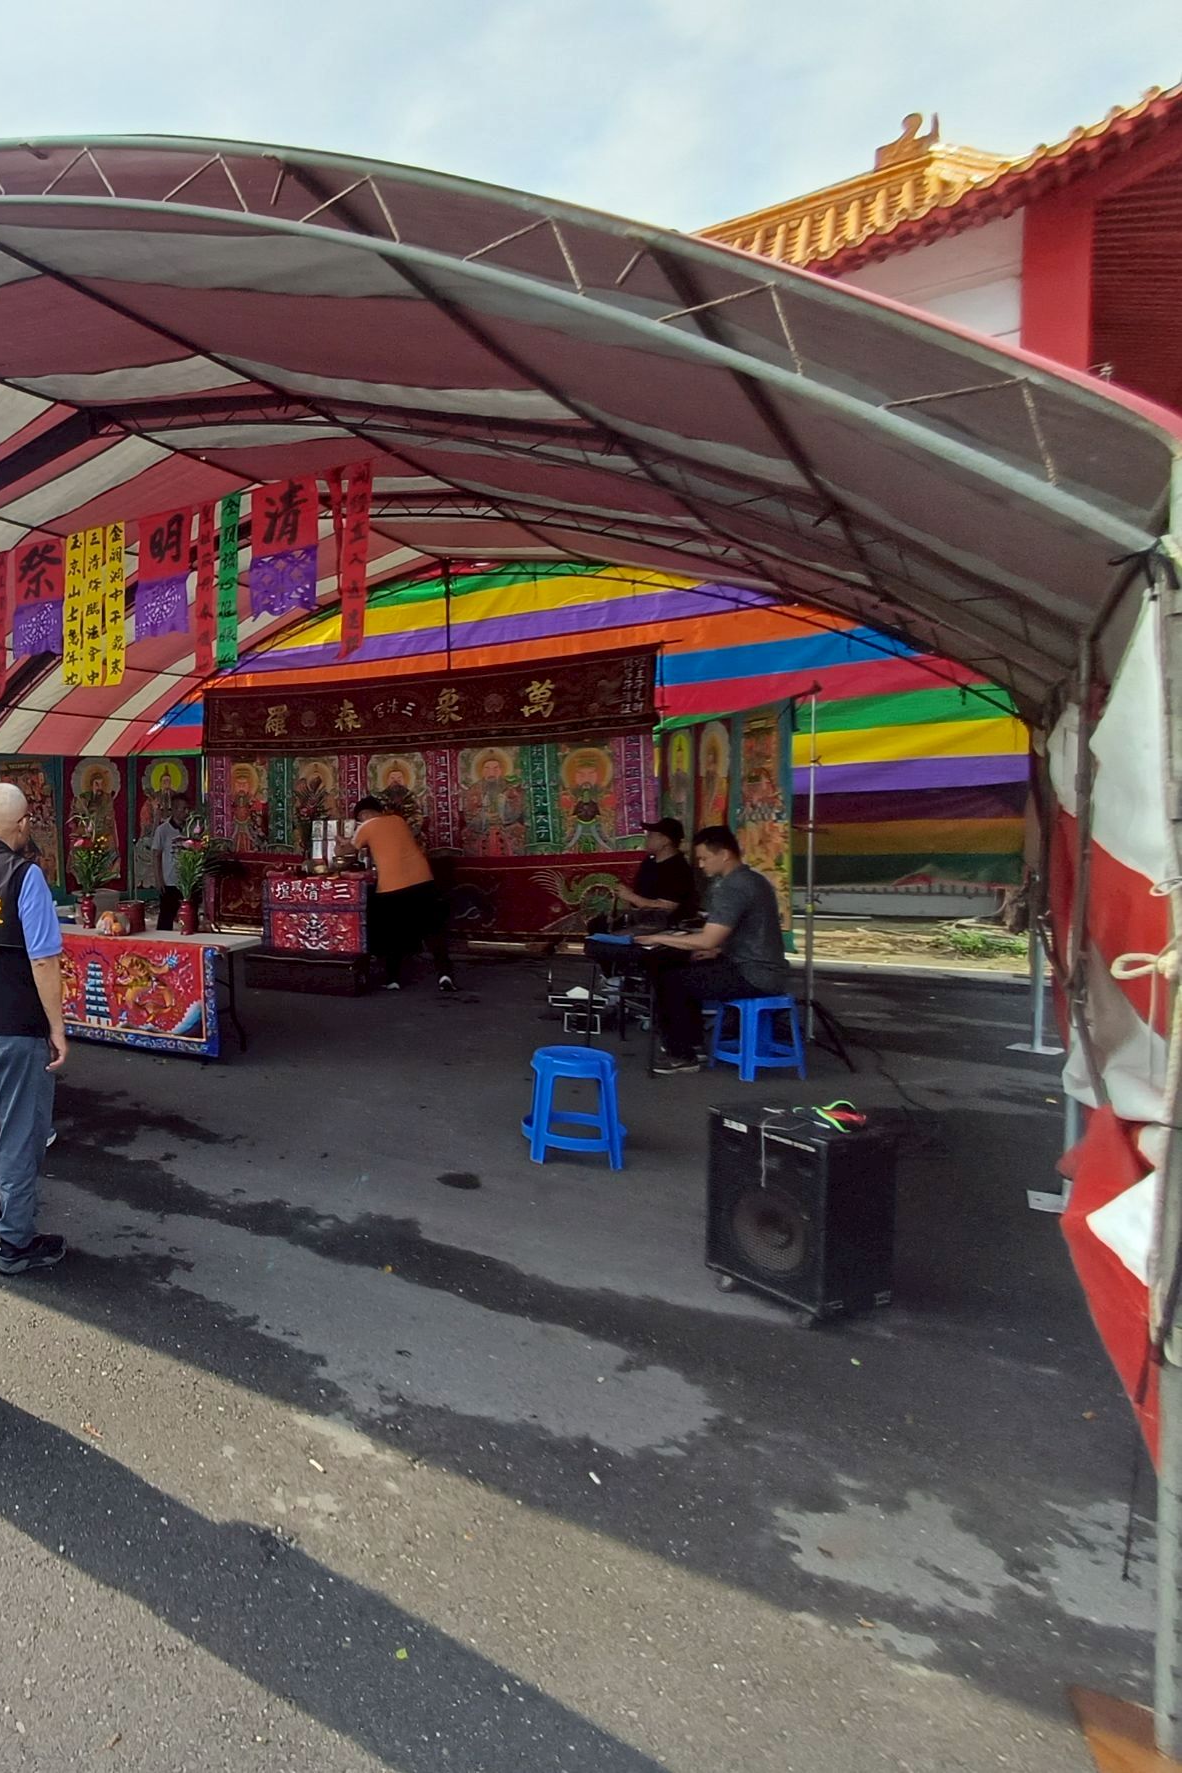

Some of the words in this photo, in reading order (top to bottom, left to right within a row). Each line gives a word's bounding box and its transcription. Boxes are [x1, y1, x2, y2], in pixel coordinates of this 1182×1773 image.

[262, 479, 307, 545] 清
[149, 513, 185, 563] 明
[17, 549, 63, 600] 祭
